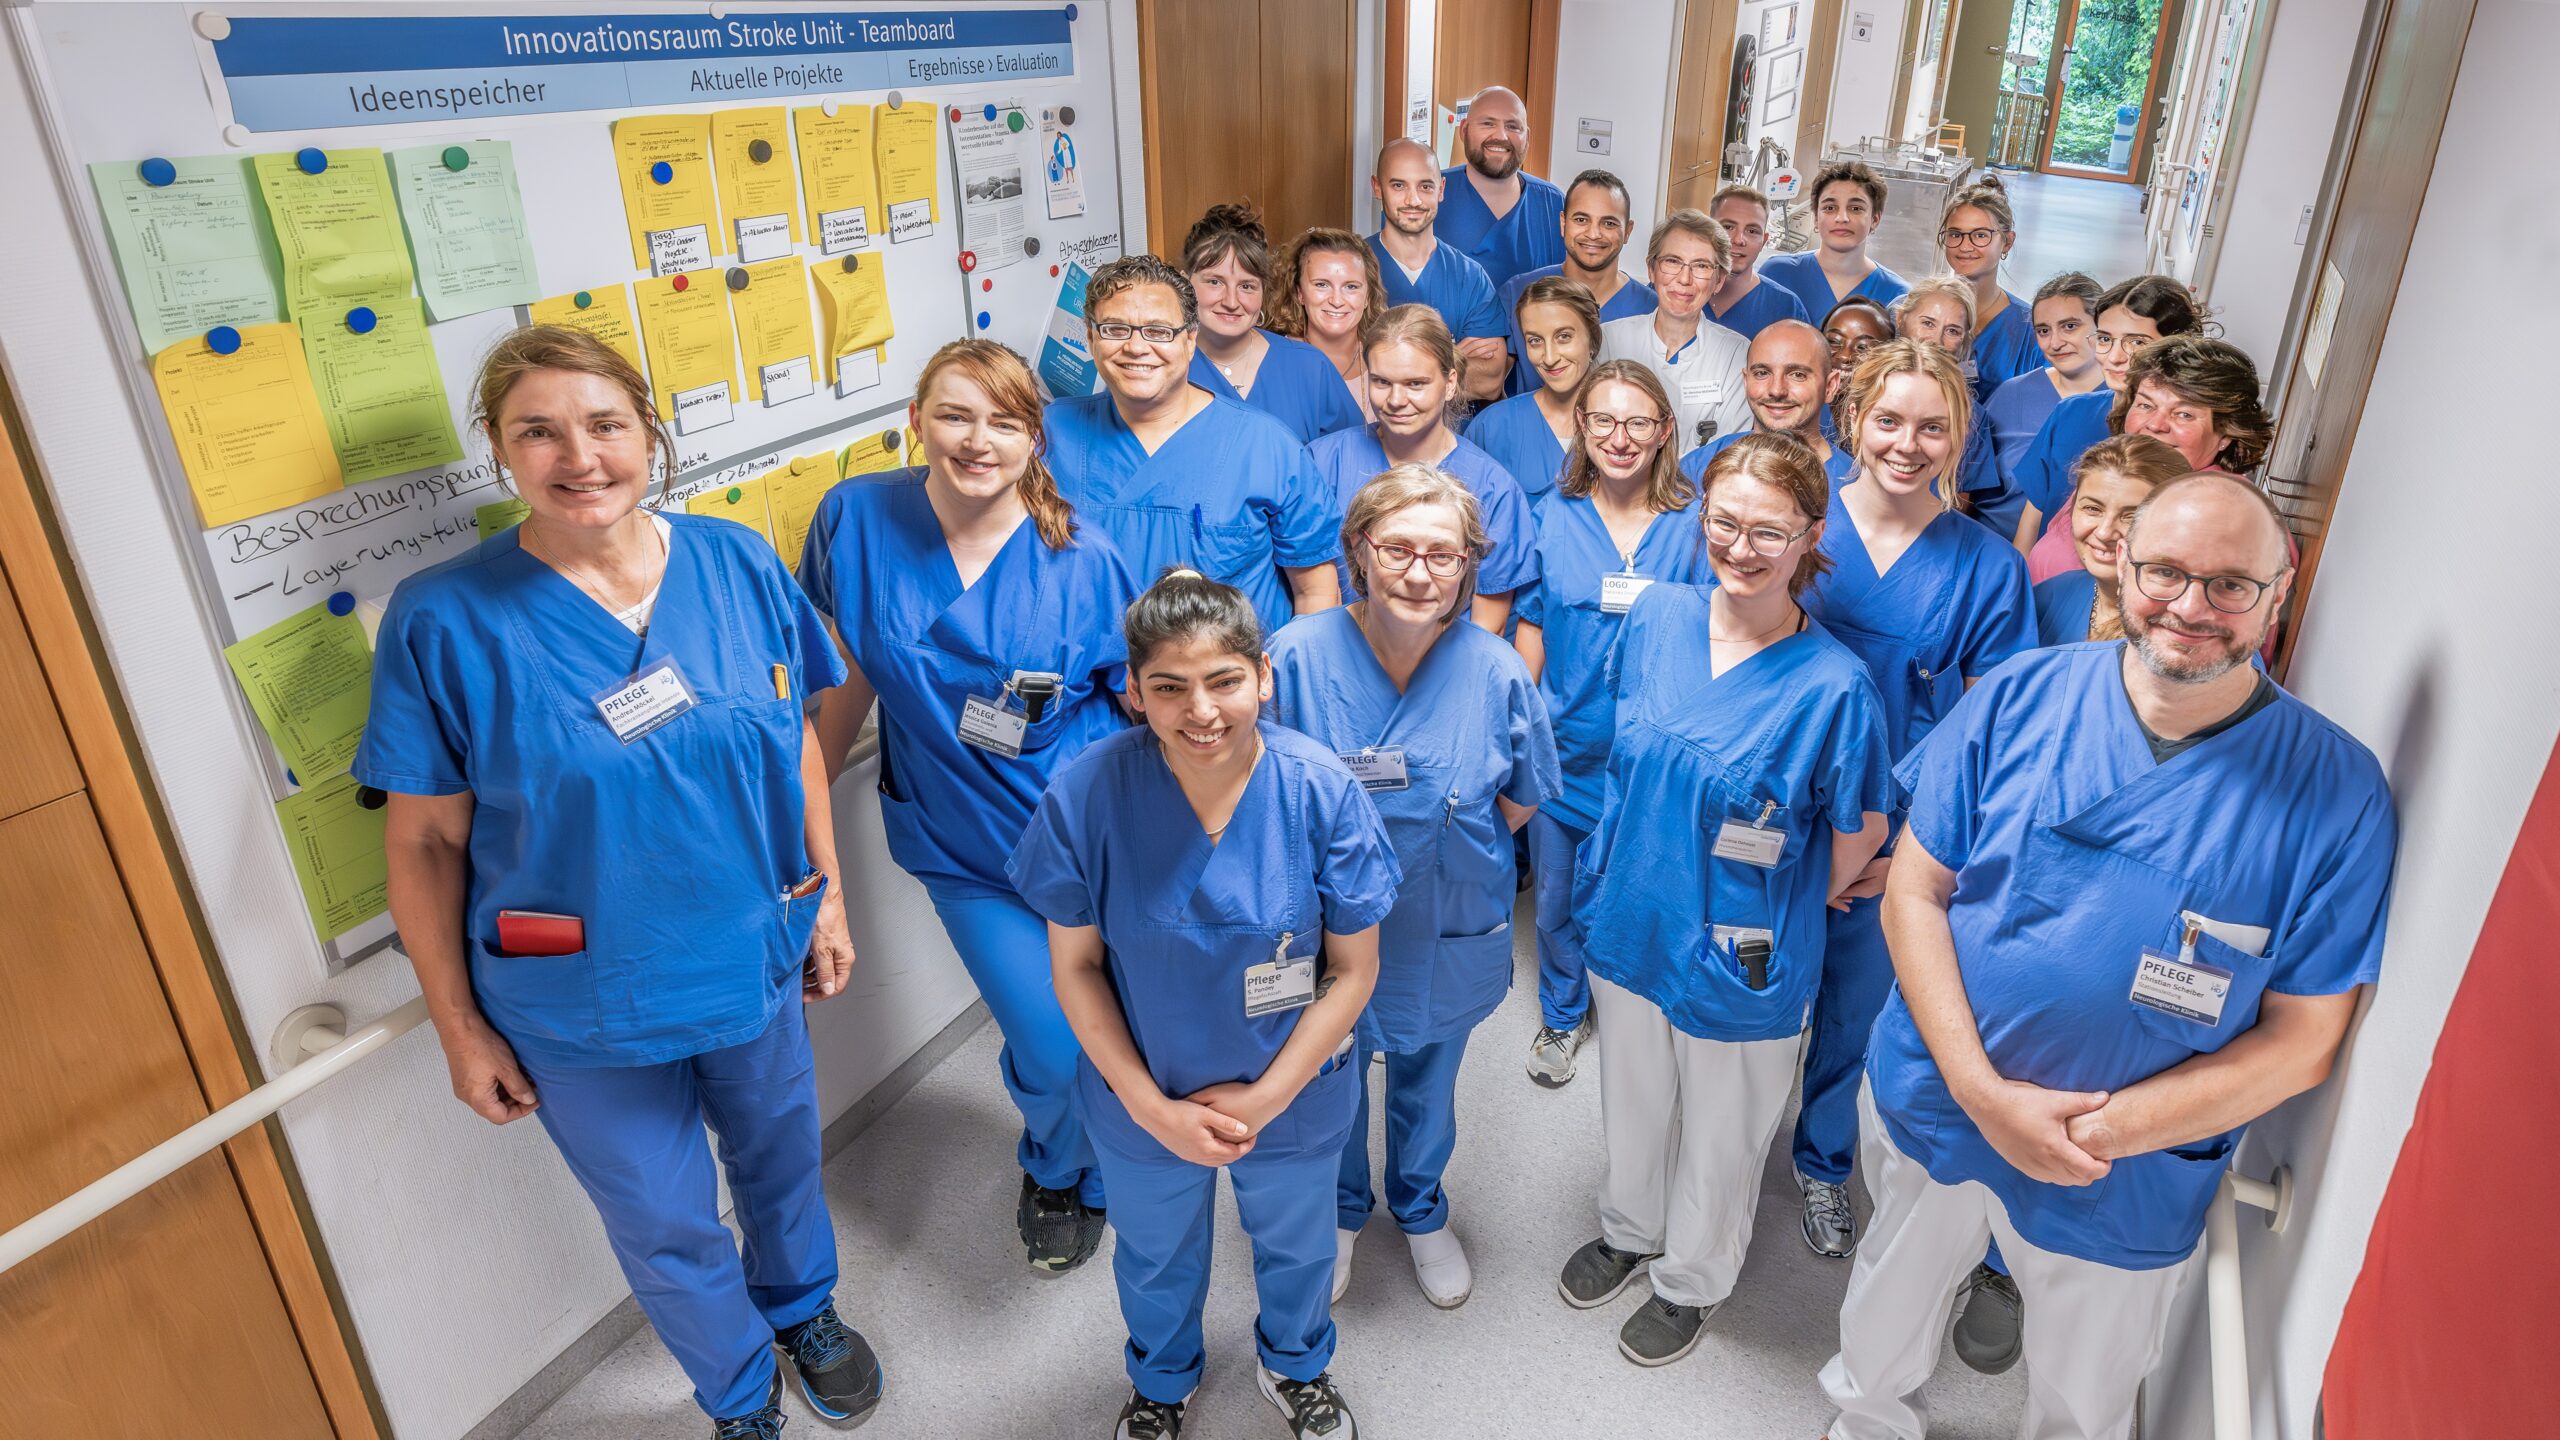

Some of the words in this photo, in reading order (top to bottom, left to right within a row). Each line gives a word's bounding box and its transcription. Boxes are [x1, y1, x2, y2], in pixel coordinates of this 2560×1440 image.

[2111, 12, 2145, 27] Ausgang
[503, 23, 722, 55] Innovationsraum
[729, 21, 797, 47] Stroke
[802, 19, 844, 45] Unit
[858, 17, 955, 43] Teamboard
[691, 66, 768, 92] Aktuelle
[774, 63, 843, 90] Projekte
[909, 55, 984, 81] Ergebnisse
[997, 52, 1058, 72] Evaluation
[349, 78, 546, 113] Ideenspeicher
[1060, 233, 1118, 260] Abgeschlossene
[1604, 580, 1628, 589] LOGO
[604, 685, 650, 714] PFLEGE
[612, 705, 633, 722] Andrea
[633, 695, 656, 711] Möckel
[966, 703, 996, 721] PFLEGE
[623, 715, 662, 741] Neurologische
[662, 708, 677, 720] Klinik
[960, 729, 993, 747] Neurologische
[994, 740, 1008, 751] Klinik
[1341, 755, 1378, 765] PFLEGE
[1247, 973, 1282, 987] Pflege
[2143, 960, 2196, 985] PFLEGE
[2140, 974, 2172, 988] Christian
[2172, 984, 2205, 999] Scheiber
[1248, 1000, 1284, 1012] Neurologische
[1284, 996, 1299, 1004] Klinik
[2134, 992, 2180, 1012] Neurologische
[2181, 1008, 2200, 1018] Klinik
